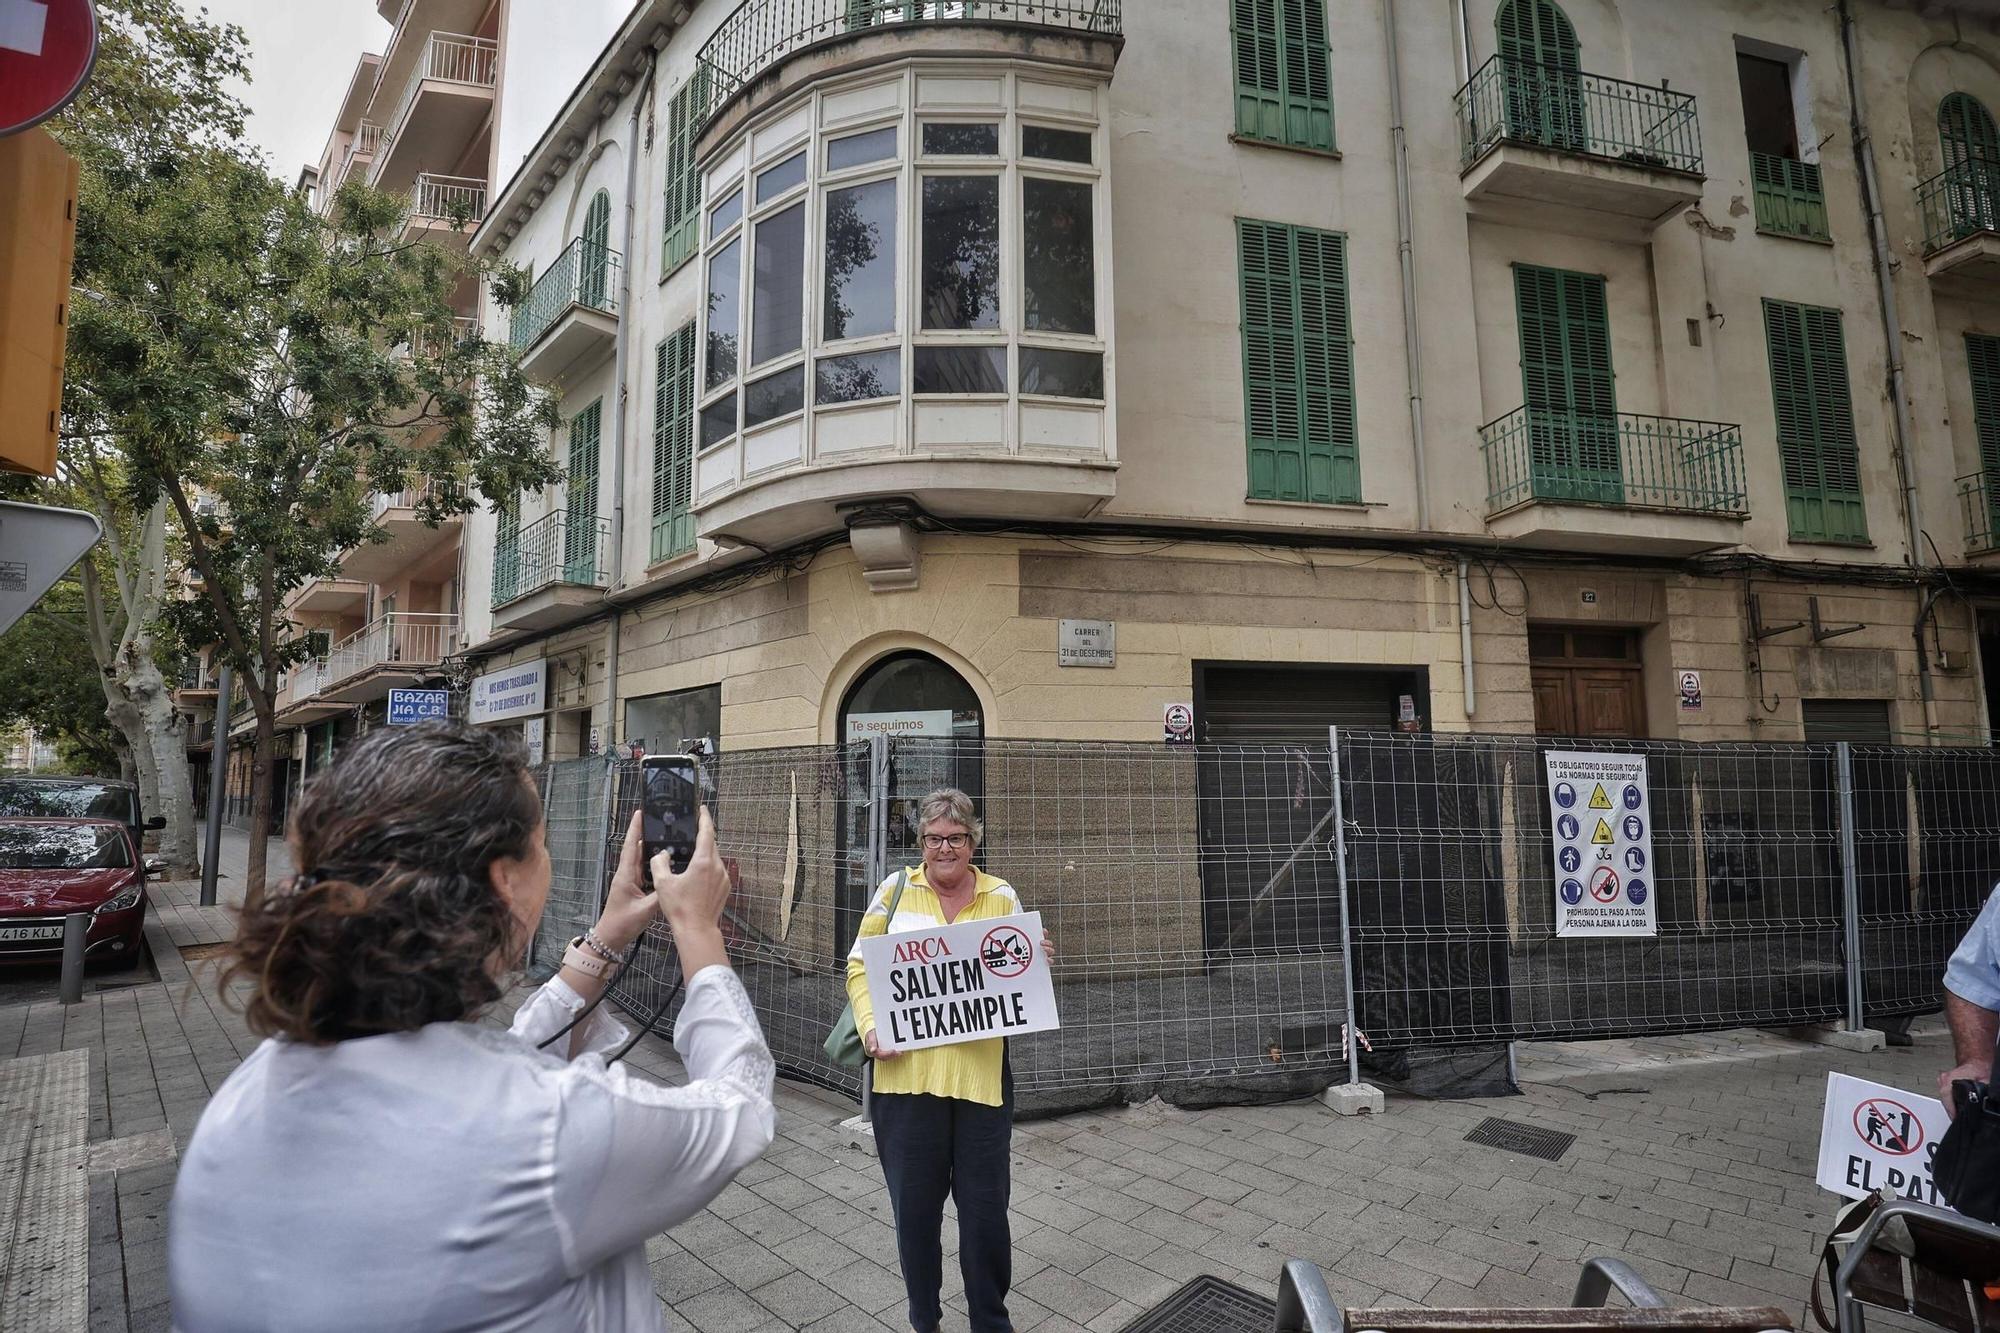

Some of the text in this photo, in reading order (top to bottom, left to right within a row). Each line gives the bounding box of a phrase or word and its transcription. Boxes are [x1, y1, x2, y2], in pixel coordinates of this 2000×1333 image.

[1074, 628, 1100, 636] CARRER
[1061, 648, 1113, 659] 31 DE DESEMBRE
[393, 692, 445, 704] BAZAR
[393, 704, 444, 716] JIA C.B.
[851, 719, 924, 733] Te seguimos
[1549, 760, 1643, 772] ES OBLIGATORIO SEGUIR TODAS
[1555, 770, 1568, 779] LAS
[1569, 771, 1595, 780] NORMAS
[1596, 772, 1604, 780] DE
[1566, 908, 1646, 917] PROHIBIDO EL PASO A TODA
[1566, 919, 1647, 928] PERSONA AJENA A LA OBRA
[32, 927, 59, 938] KLX
[891, 936, 952, 965] ARCA
[890, 957, 985, 1003] SALVEM
[890, 992, 1028, 1044] L'EIXAMPLE
[1846, 1154, 1953, 1207] EL PAT
